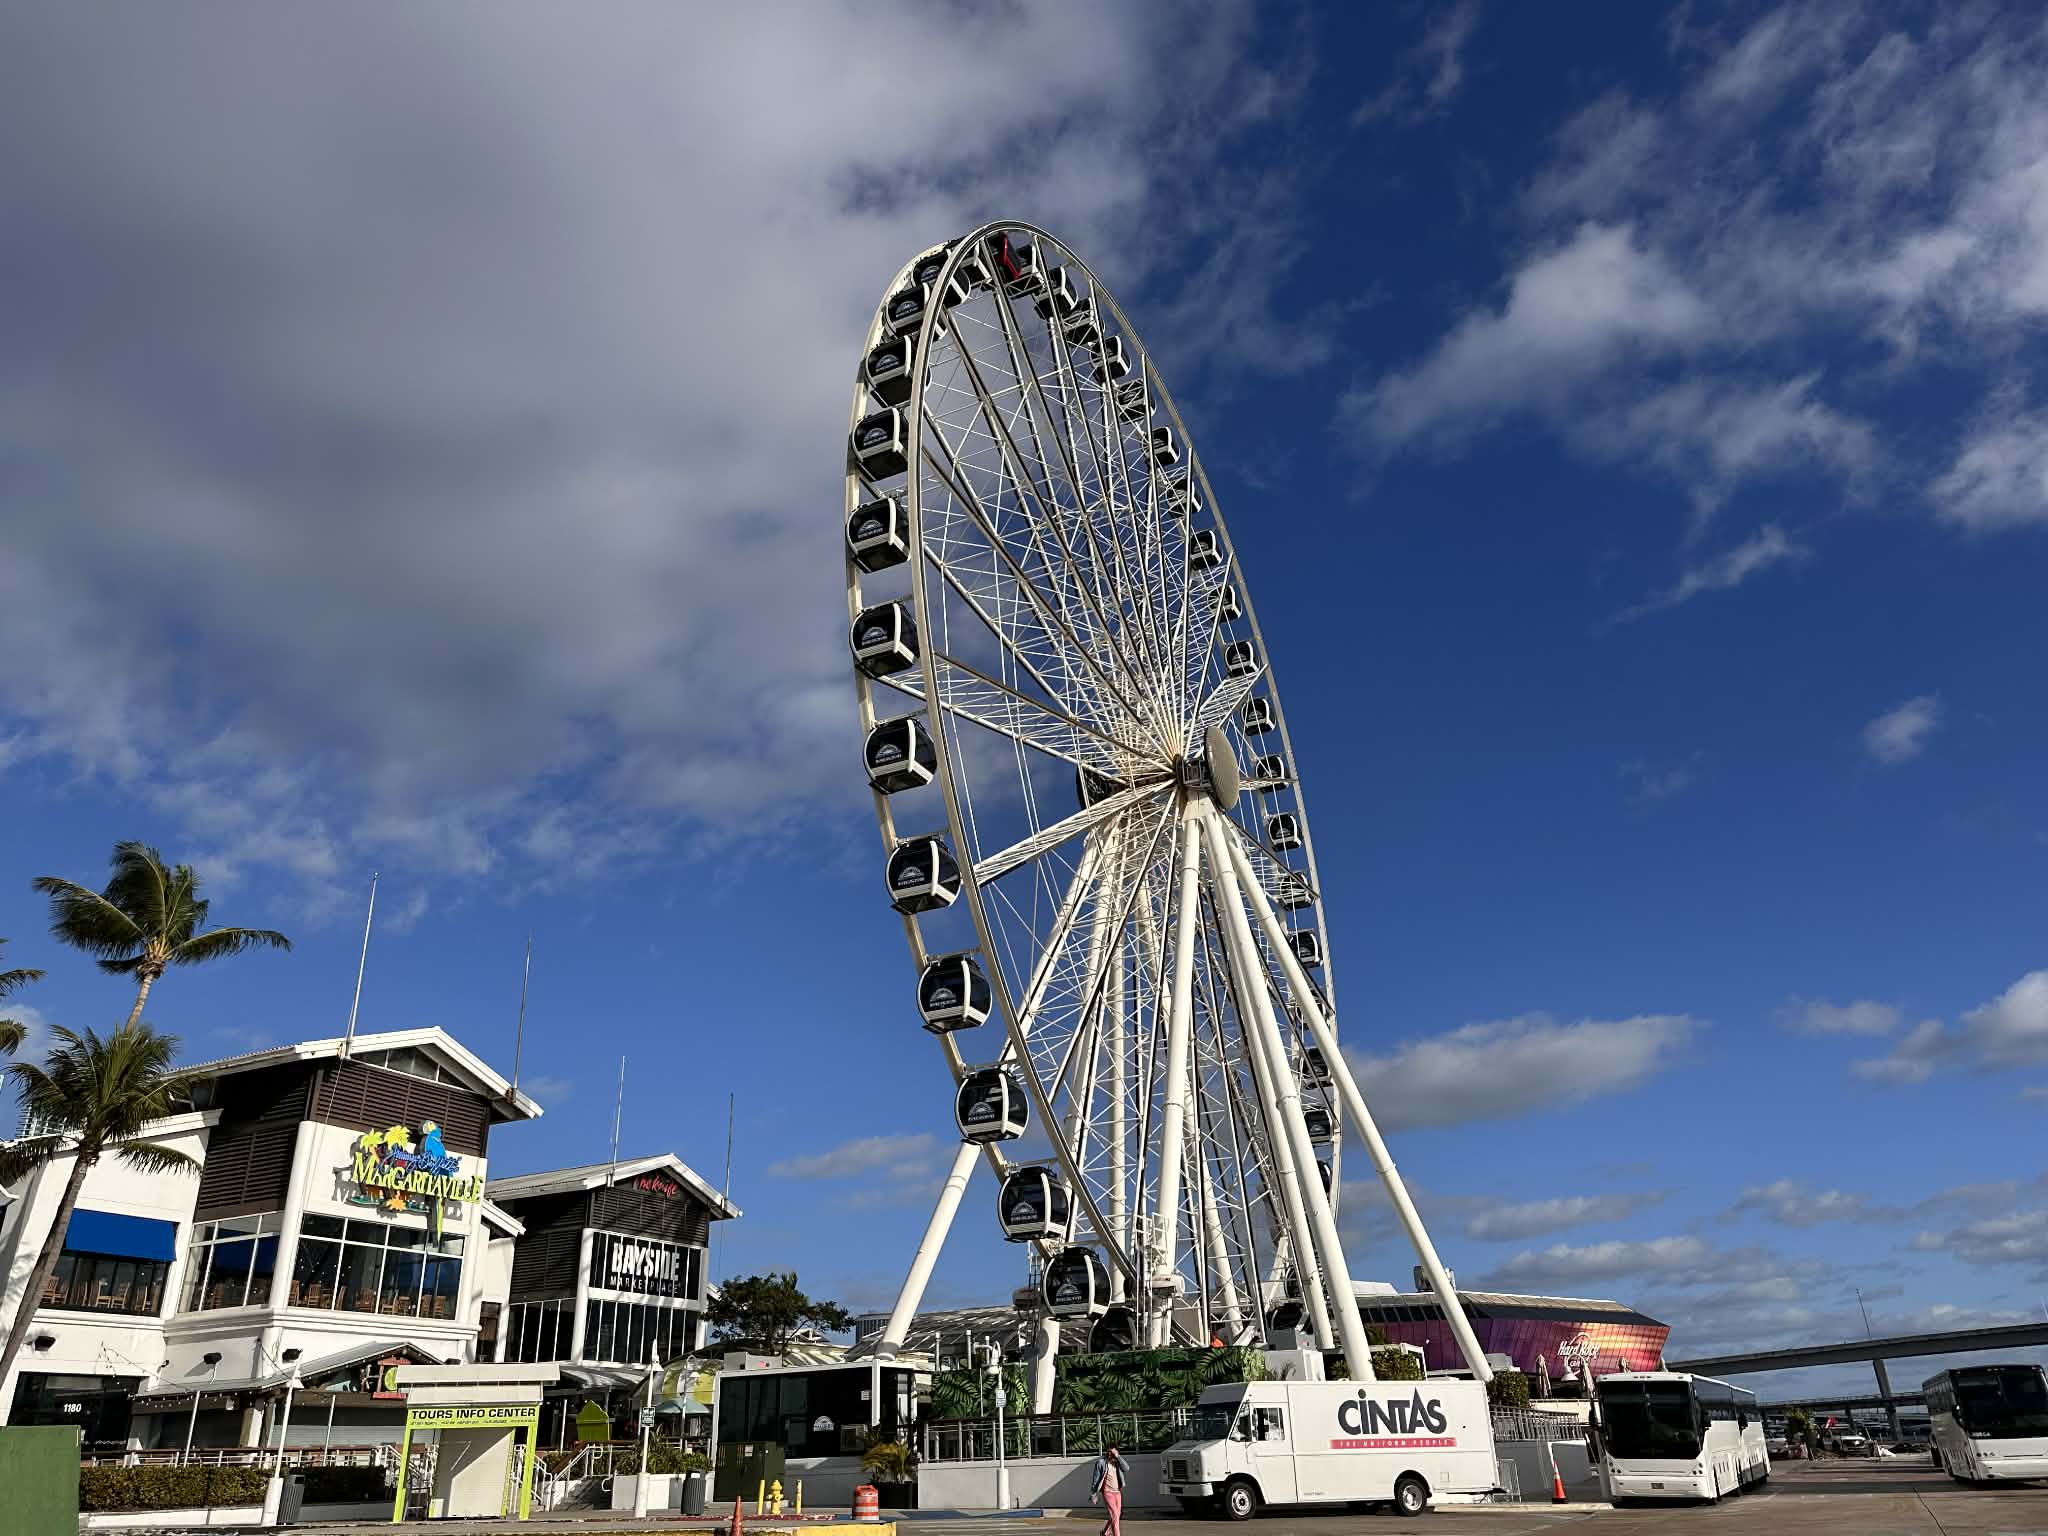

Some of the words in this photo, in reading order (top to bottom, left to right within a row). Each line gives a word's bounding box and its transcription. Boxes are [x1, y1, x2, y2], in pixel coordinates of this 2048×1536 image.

[351, 1152, 483, 1203] MARGARITAVILLE
[611, 1242, 681, 1281] BAYSIDE
[63, 1403, 82, 1413] 1180
[411, 1409, 453, 1419] TOURS
[456, 1409, 485, 1419] INFO
[488, 1408, 536, 1418] CENTER
[1337, 1386, 1448, 1435] CINTAS
